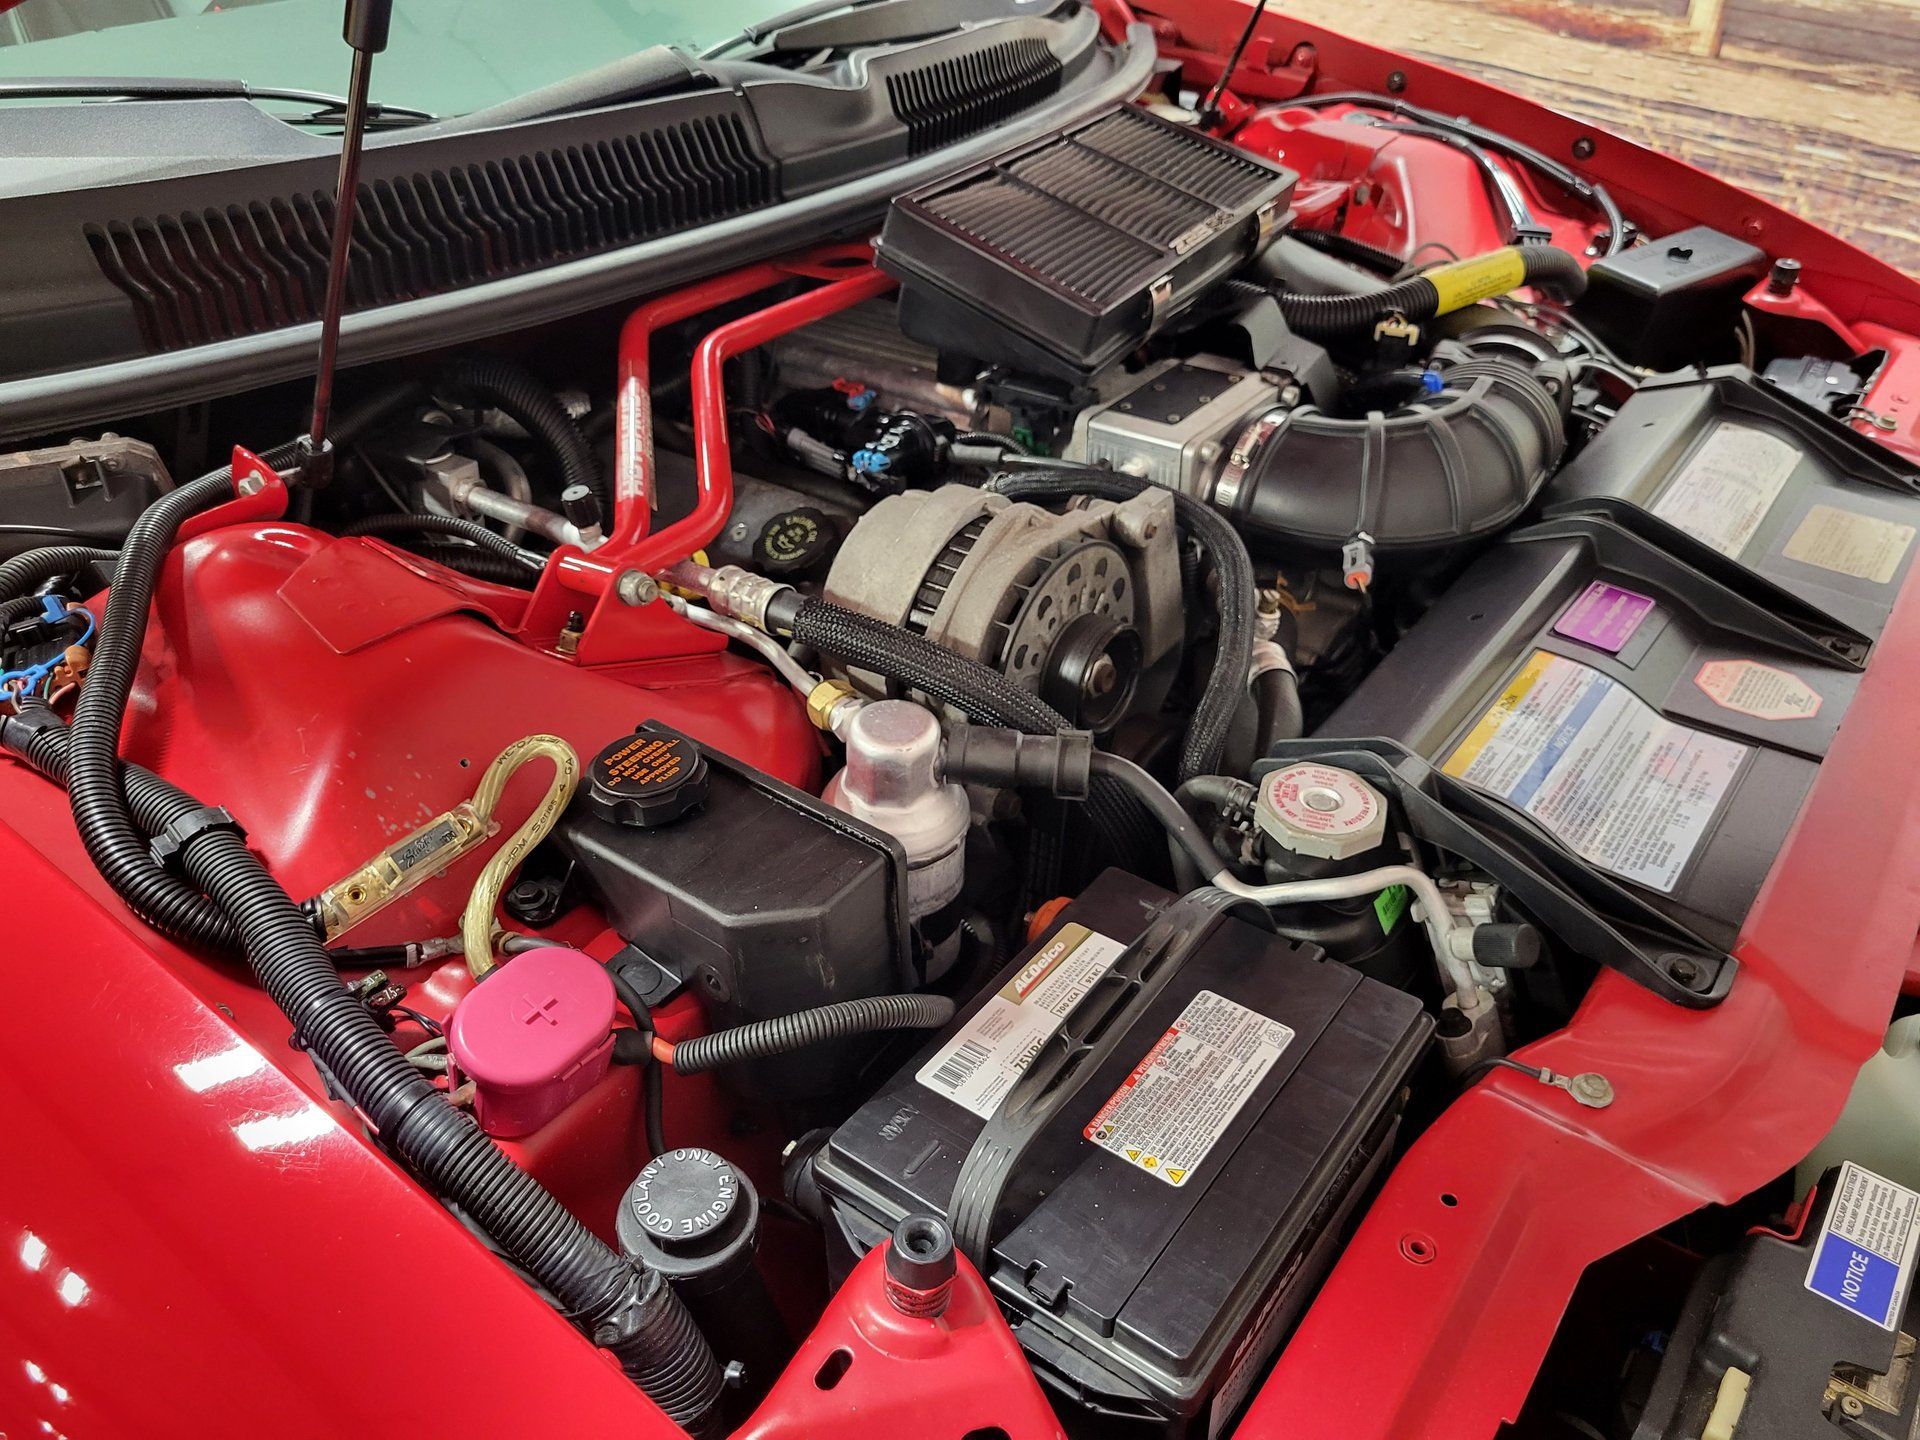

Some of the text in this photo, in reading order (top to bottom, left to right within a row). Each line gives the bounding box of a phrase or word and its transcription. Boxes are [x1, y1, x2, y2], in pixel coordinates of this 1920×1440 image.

[604, 739, 646, 765] POWER
[607, 740, 680, 786] DO NOT OVERFILL
[609, 741, 664, 775] STEERING
[632, 753, 671, 779] USE ONLY
[640, 757, 681, 784] APPROVED
[656, 767, 679, 782] FLUID
[504, 757, 573, 866] HPM Series 4 GA
[1009, 939, 1067, 993] ACDelco
[1032, 974, 1064, 1004] MAINTENANCE
[1062, 964, 1074, 974] FREE
[1084, 968, 1101, 983] 95 RC
[383, 985, 398, 1000] 7.5
[1055, 991, 1080, 1014] 700 CCA
[1091, 1084, 1131, 1127] DANGER/POISON
[1136, 1031, 1175, 1073] PELIGRO/VENENO
[634, 1149, 736, 1234] ENGINE COOLANT ONLY
[1833, 1169, 1859, 1232] HEADLAMP ADJUSTMENT
[1845, 1175, 1869, 1236] HEADLAMP REPLACEMENT
[1839, 1249, 1868, 1303] NOTICE
[1887, 1310, 1895, 1328] PRINTED
[1892, 1289, 1900, 1306] CANADA
